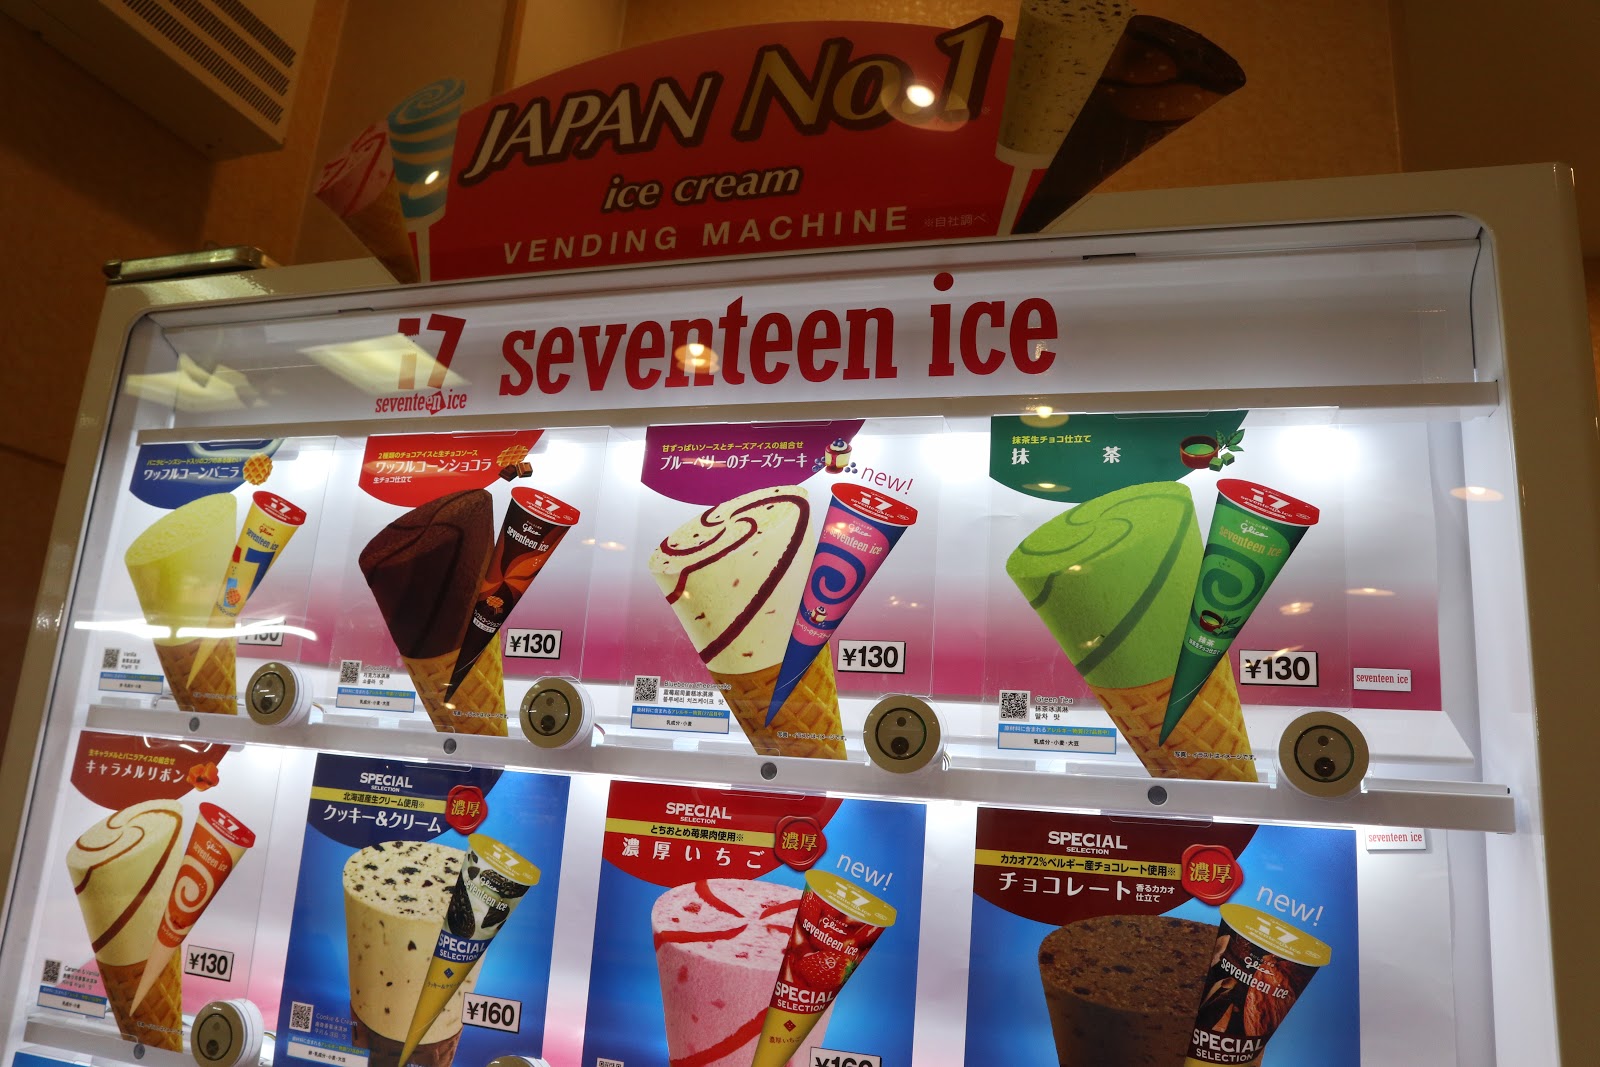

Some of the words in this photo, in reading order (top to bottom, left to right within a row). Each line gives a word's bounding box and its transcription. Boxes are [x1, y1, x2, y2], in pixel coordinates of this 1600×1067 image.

[460, 74, 719, 183] JAPAN
[603, 175, 663, 211] ice
[673, 165, 801, 205] cream
[503, 227, 677, 264] VENDING
[702, 207, 908, 246] MACHINE
[499, 296, 896, 397] seventeen
[928, 272, 1058, 378] ice
[375, 391, 446, 414] seventeen
[446, 388, 467, 410] ice
[662, 441, 804, 452] 甘ずっぱいソースとチーズアイスの組合せ
[1012, 434, 1092, 444] 抹茶生チョコ仕立て
[376, 458, 492, 474] ワッフルコーンショコラ
[660, 453, 808, 471] ブルーベリーのチーズケーキ
[144, 466, 240, 481] ワッフルコーンバニラ
[861, 466, 914, 495] new!
[506, 526, 539, 549] seventeen
[537, 541, 549, 552] ice
[522, 523, 541, 536] Glico
[848, 523, 872, 537] Glico
[1240, 522, 1269, 538] Glico
[829, 528, 869, 553] seventeen
[869, 543, 882, 555] ice
[1219, 525, 1266, 554] seventeen
[1267, 544, 1282, 558] ice
[510, 633, 556, 654] ¥130
[842, 645, 899, 668] ¥130
[1245, 655, 1311, 680] ¥130
[1356, 673, 1394, 684] seventeen
[1397, 673, 1409, 684] ice
[1035, 695, 1058, 704] Green
[1060, 695, 1074, 705] Tea
[86, 760, 184, 783] キャラメルリボン
[360, 772, 413, 789] SPECIAL
[371, 785, 400, 793] SELECTION
[323, 804, 442, 833] クッキー&クリーム
[451, 800, 481, 817] 濃厚
[665, 802, 732, 820] SPECIAL
[680, 816, 716, 824] SELECTION
[781, 831, 818, 851] 濃厚
[1047, 830, 1128, 850] SPECIAL
[1368, 832, 1408, 843] seventeen
[1410, 832, 1422, 843] ice
[1066, 846, 1110, 855] SELECTION
[836, 852, 893, 892] new!
[1189, 862, 1233, 883] 濃厚
[463, 880, 496, 907] seventeen
[496, 899, 507, 911] ice
[998, 871, 1131, 901] チョコレート
[1135, 883, 1176, 895] 香るカカオ
[1135, 892, 1160, 903] 仕立て
[1256, 884, 1324, 928] new!
[822, 917, 847, 935] Glico
[438, 933, 486, 954] SPECIAL
[803, 919, 844, 951] seventeen
[844, 942, 858, 956] ice
[188, 952, 229, 976] ¥130
[1244, 956, 1274, 976] Glico
[1221, 957, 1271, 994] seventeen
[1272, 983, 1288, 999] ice
[775, 981, 834, 1004] SPECIAL
[466, 1001, 515, 1027] ¥160
[777, 998, 826, 1012] SELECTION
[1192, 1028, 1263, 1054] SPECIAL
[1196, 1048, 1254, 1063] SELECTION
